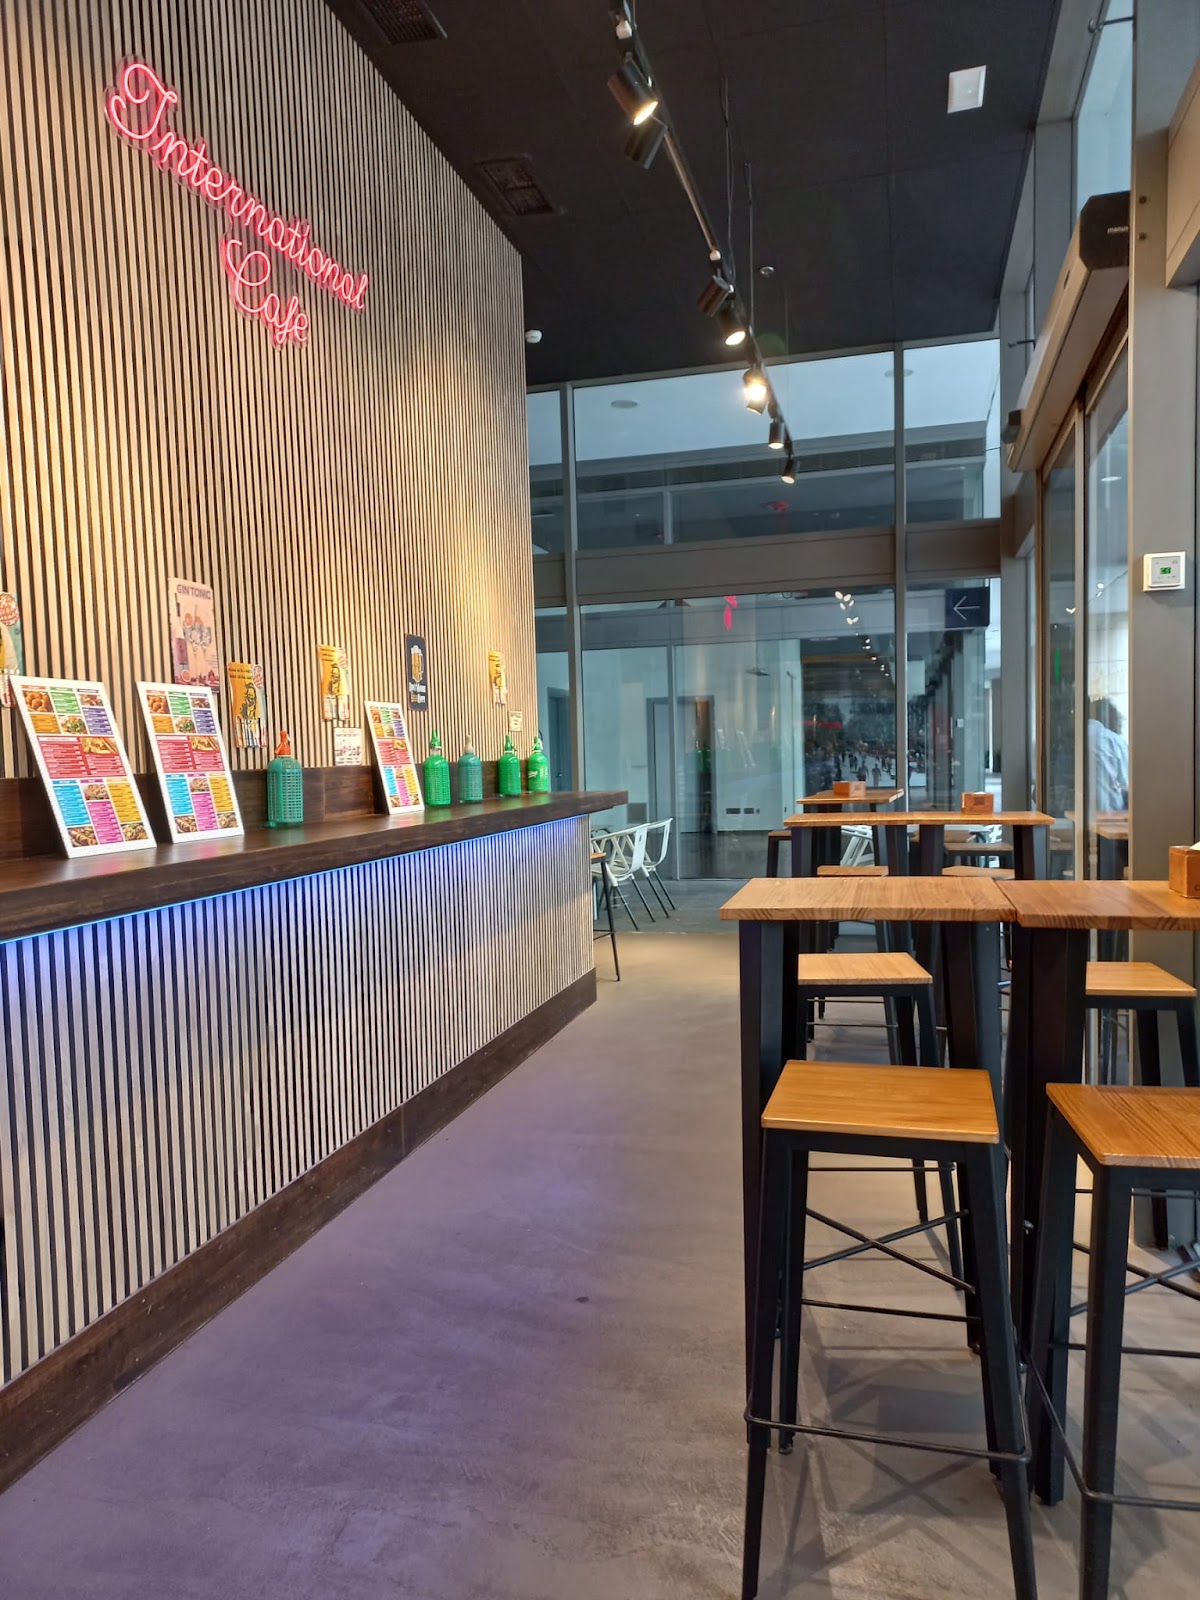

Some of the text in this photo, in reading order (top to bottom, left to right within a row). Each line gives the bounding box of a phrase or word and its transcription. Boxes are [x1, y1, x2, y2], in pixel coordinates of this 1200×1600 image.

[108, 62, 369, 310] International
[225, 238, 309, 345] Cafe
[176, 583, 211, 600] GIN TONIC
